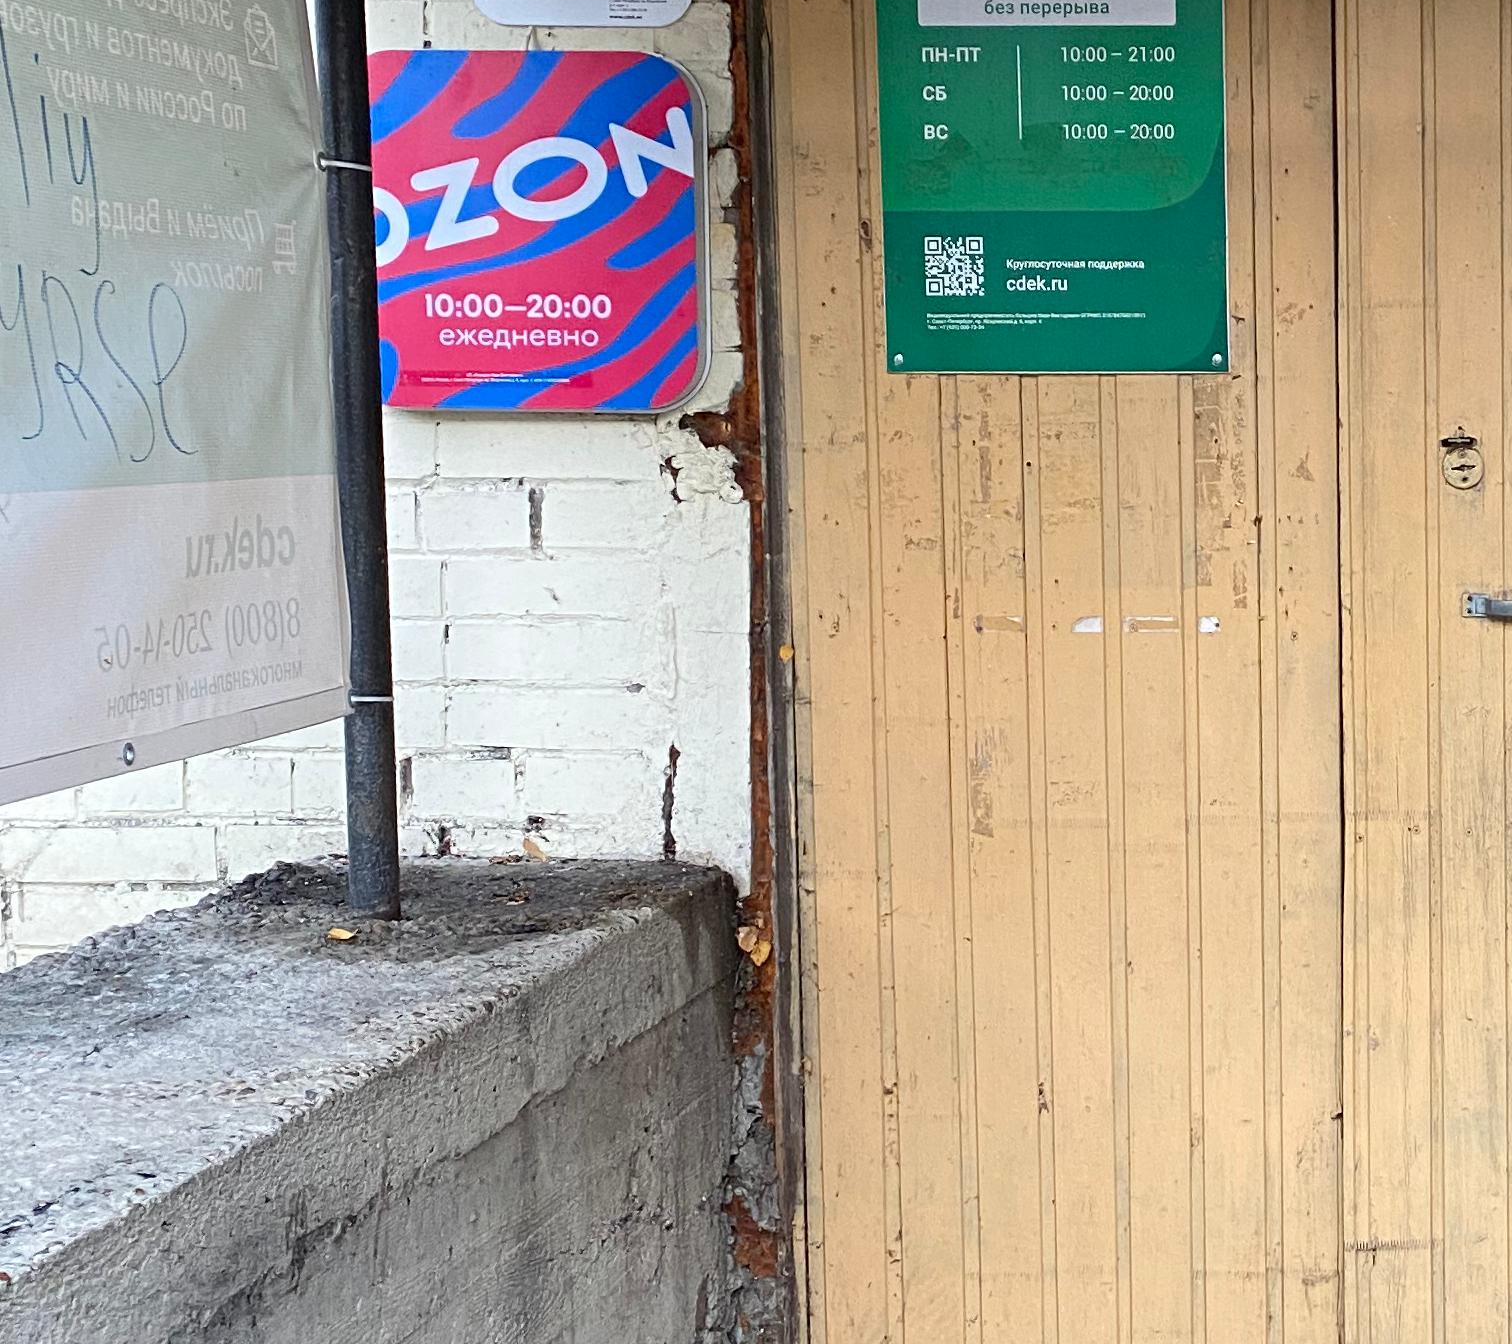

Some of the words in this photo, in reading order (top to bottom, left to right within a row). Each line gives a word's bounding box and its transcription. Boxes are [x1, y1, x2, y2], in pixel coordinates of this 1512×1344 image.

[984, 0, 1015, 16] без
[1020, 1, 1110, 19] перерыва
[921, 47, 982, 63] ПН-ПТ
[1061, 47, 1108, 63] 10:00
[1128, 47, 1176, 63] 21:00
[922, 86, 948, 102] СБ
[1062, 86, 1108, 102] 10:00
[1129, 86, 1174, 102] 20:00
[924, 125, 949, 141] ВС
[1063, 125, 1108, 141] 10:00
[1130, 125, 1176, 141] 20:00
[1006, 258, 1086, 271] Круглосуточная
[1088, 259, 1145, 271] поддержка
[1006, 275, 1068, 291] cdek.ru
[439, 328, 600, 350] ежедневно
